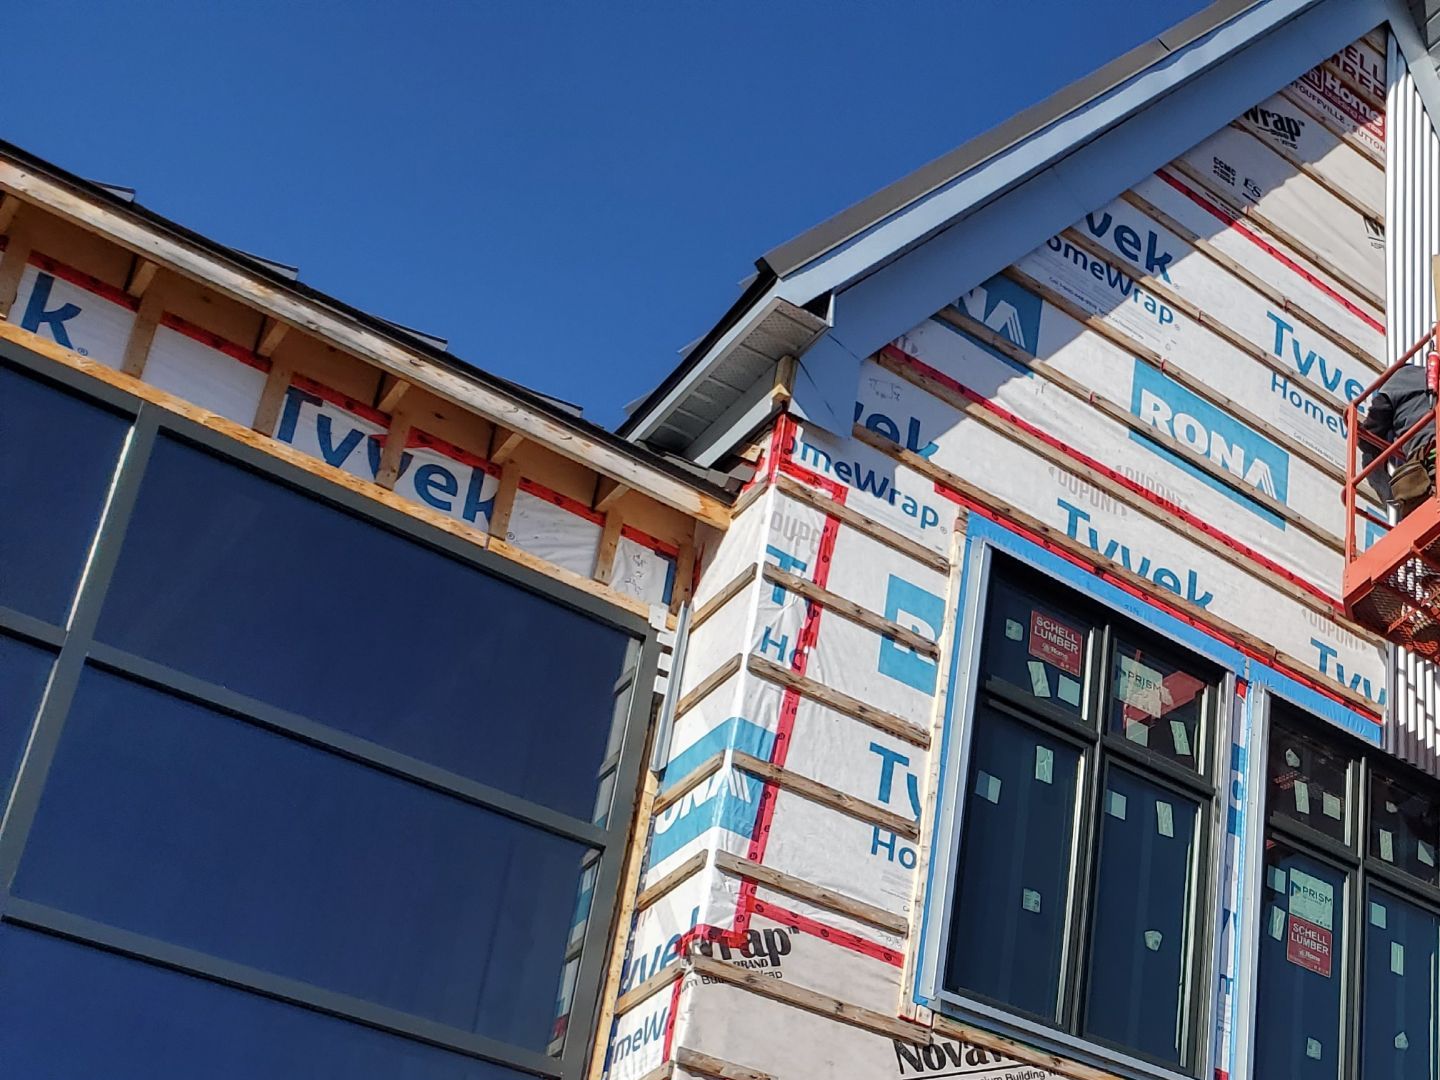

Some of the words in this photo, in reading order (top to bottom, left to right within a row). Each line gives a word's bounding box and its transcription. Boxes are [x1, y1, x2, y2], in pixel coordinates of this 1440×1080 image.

[1046, 235, 1174, 326] omeWrap
[1085, 212, 1173, 285] vek
[1266, 310, 1370, 414] Tyve
[1139, 388, 1278, 501] RONA
[782, 434, 940, 530] omeWrap
[1034, 626, 1079, 655] LUMBER
[1035, 616, 1078, 644] SCHELL
[1310, 636, 1387, 706] Tyv
[1302, 885, 1333, 904] PRISM
[1291, 932, 1330, 956] LUMBER
[1292, 922, 1328, 945] SCHELL
